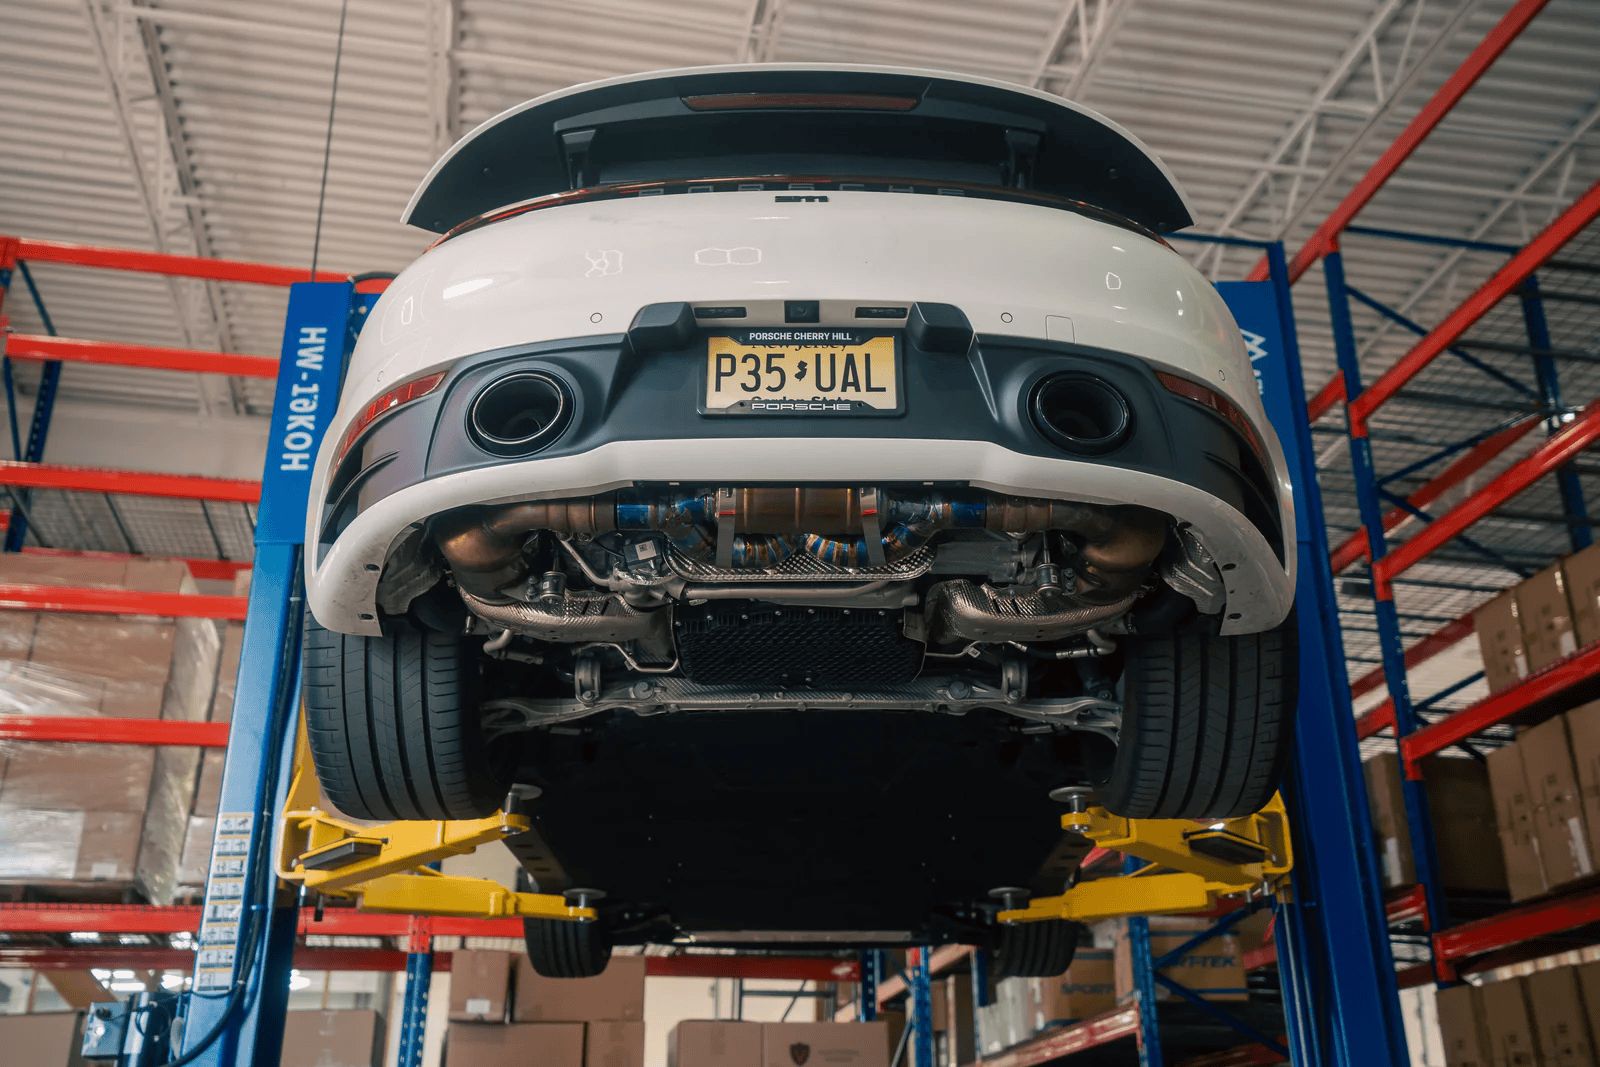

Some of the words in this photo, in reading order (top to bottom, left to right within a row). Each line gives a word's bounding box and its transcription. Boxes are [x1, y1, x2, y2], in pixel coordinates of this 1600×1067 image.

[749, 332, 792, 340] PORSCHE
[793, 332, 830, 340] CHERRY
[832, 332, 852, 340] HILL
[714, 353, 787, 393] P35
[814, 353, 887, 393] UAL
[751, 403, 851, 411] PORSCHE
